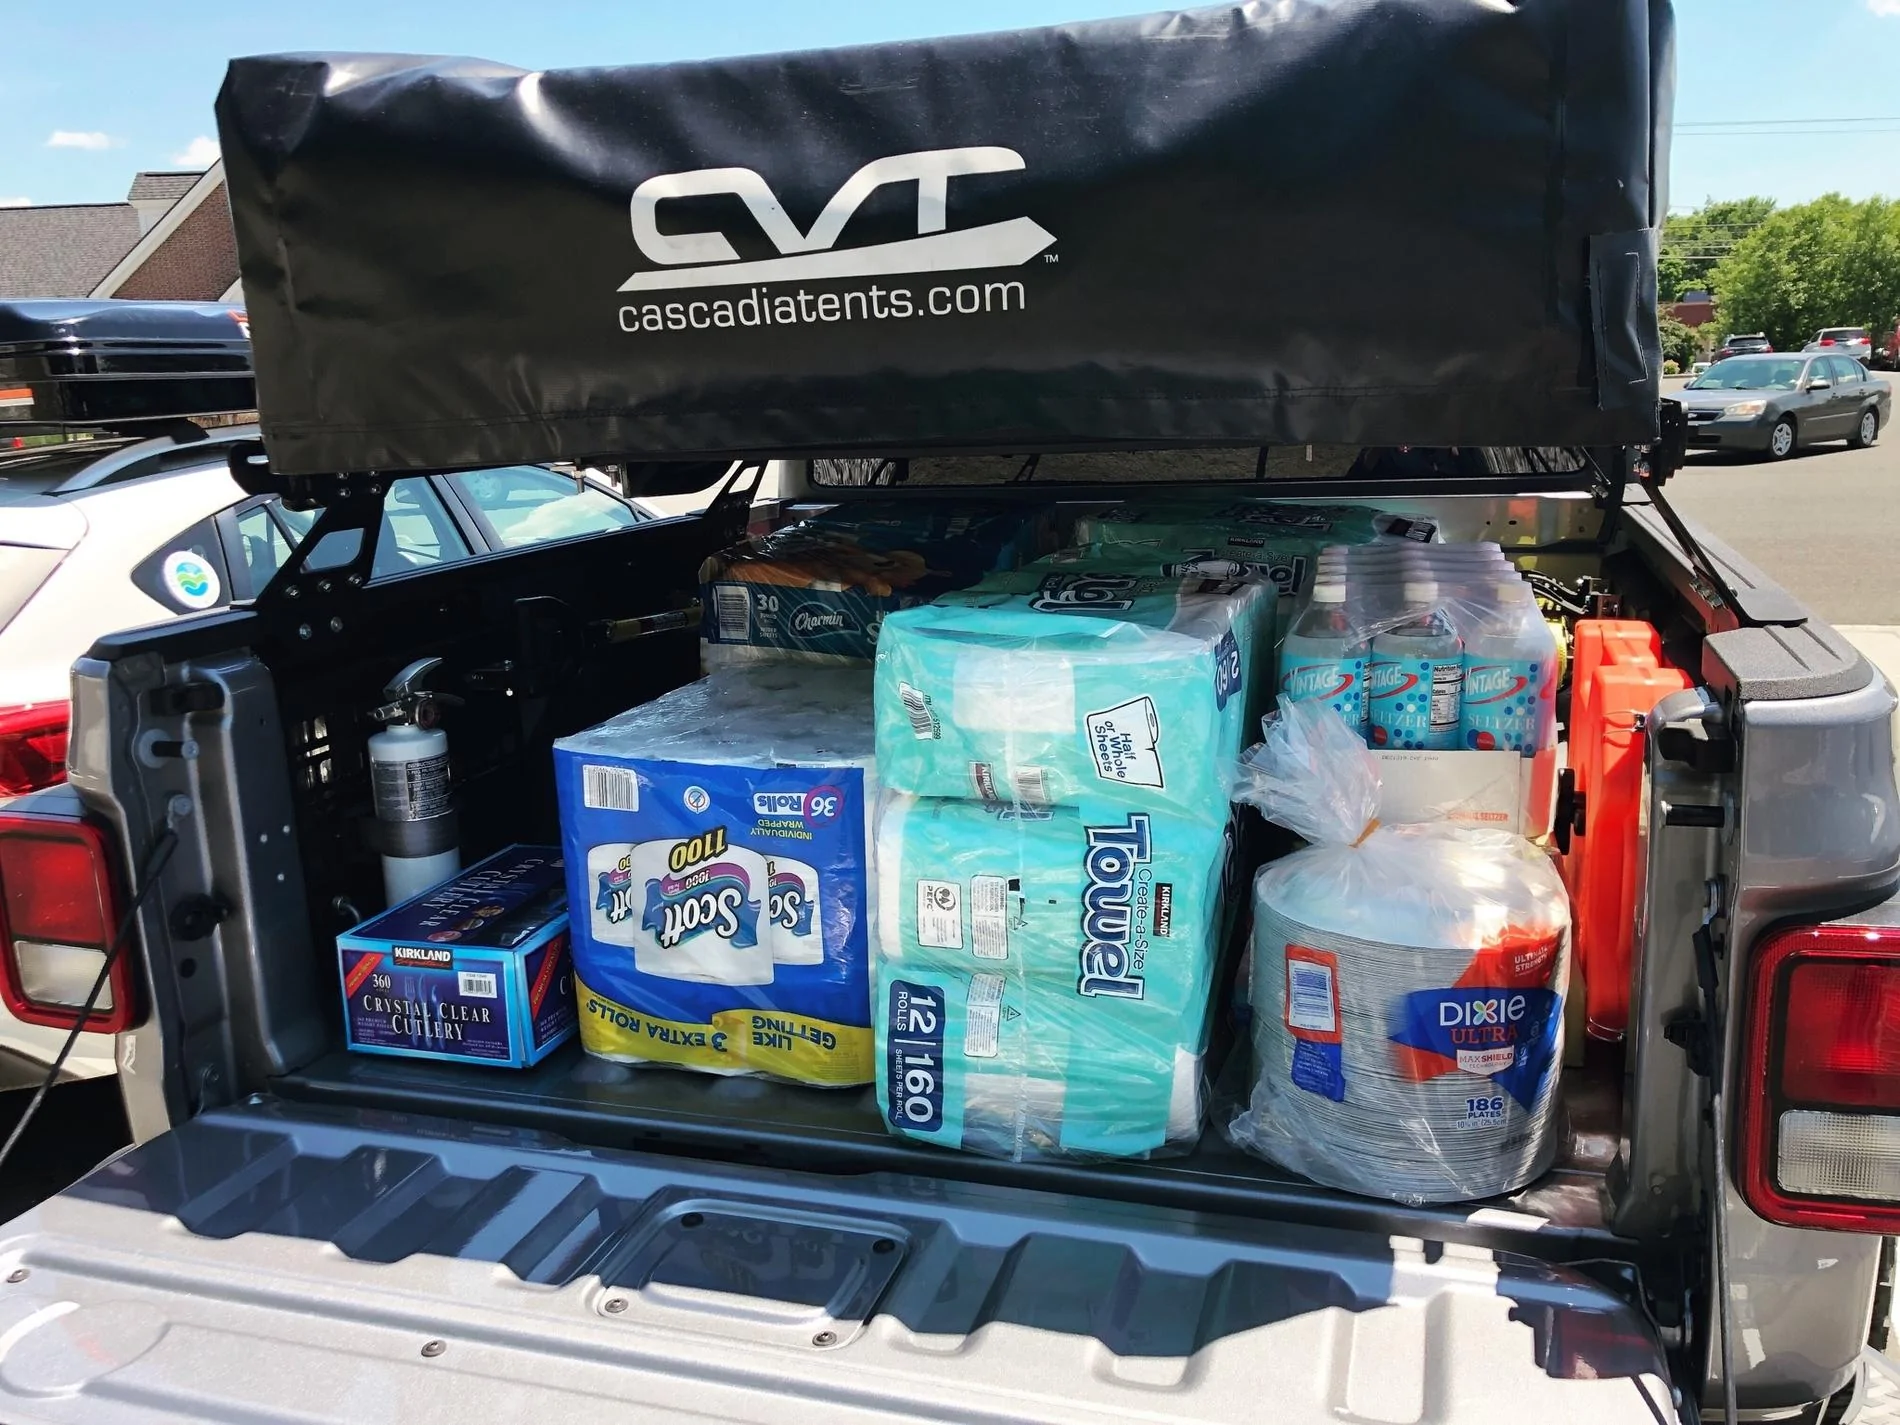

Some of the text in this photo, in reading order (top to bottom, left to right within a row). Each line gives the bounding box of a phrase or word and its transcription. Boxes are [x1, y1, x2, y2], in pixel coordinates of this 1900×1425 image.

[617, 281, 1026, 333] cascadiatents.com
[757, 594, 779, 612] 30
[795, 612, 844, 631] Charmin
[1290, 665, 1341, 699] VINTAGE
[1371, 663, 1402, 690] NTAGE
[1465, 667, 1511, 699] VINTAGE
[1468, 714, 1536, 731] SELTZER
[1094, 724, 1114, 773] Sheets
[1104, 720, 1127, 779] or Whole
[1120, 732, 1137, 760] Half
[981, 765, 995, 800] KIRKLA
[758, 794, 838, 817] 36 Rolls
[751, 827, 813, 841] INDIVIDUALLY
[758, 819, 804, 830] WRAPPED
[669, 827, 727, 871] 1100
[685, 872, 711, 889] 1000
[925, 884, 933, 911] PEFC
[1078, 812, 1152, 1001] Towel
[1159, 885, 1172, 936] KIRKLAND
[661, 888, 742, 948] Scott
[1132, 868, 1153, 971] Create-a-Size
[394, 946, 451, 962] KIRKLAND
[372, 973, 391, 989] 360
[363, 994, 491, 1023] CRYSTAL CLEAR
[896, 991, 908, 1032] ROLLS
[392, 1014, 464, 1041] CUTLERY
[648, 1023, 707, 1047] EXTRA
[752, 1015, 837, 1049] GETTING
[1451, 1022, 1519, 1045] ULTRA
[711, 1032, 728, 1053] 3
[752, 1032, 792, 1051] LIKE
[904, 994, 937, 1124] 12 160
[894, 1048, 904, 1121] SHEETS PER ROLL
[1466, 1097, 1504, 1112] 186
[1467, 1110, 1502, 1119] PLATES
